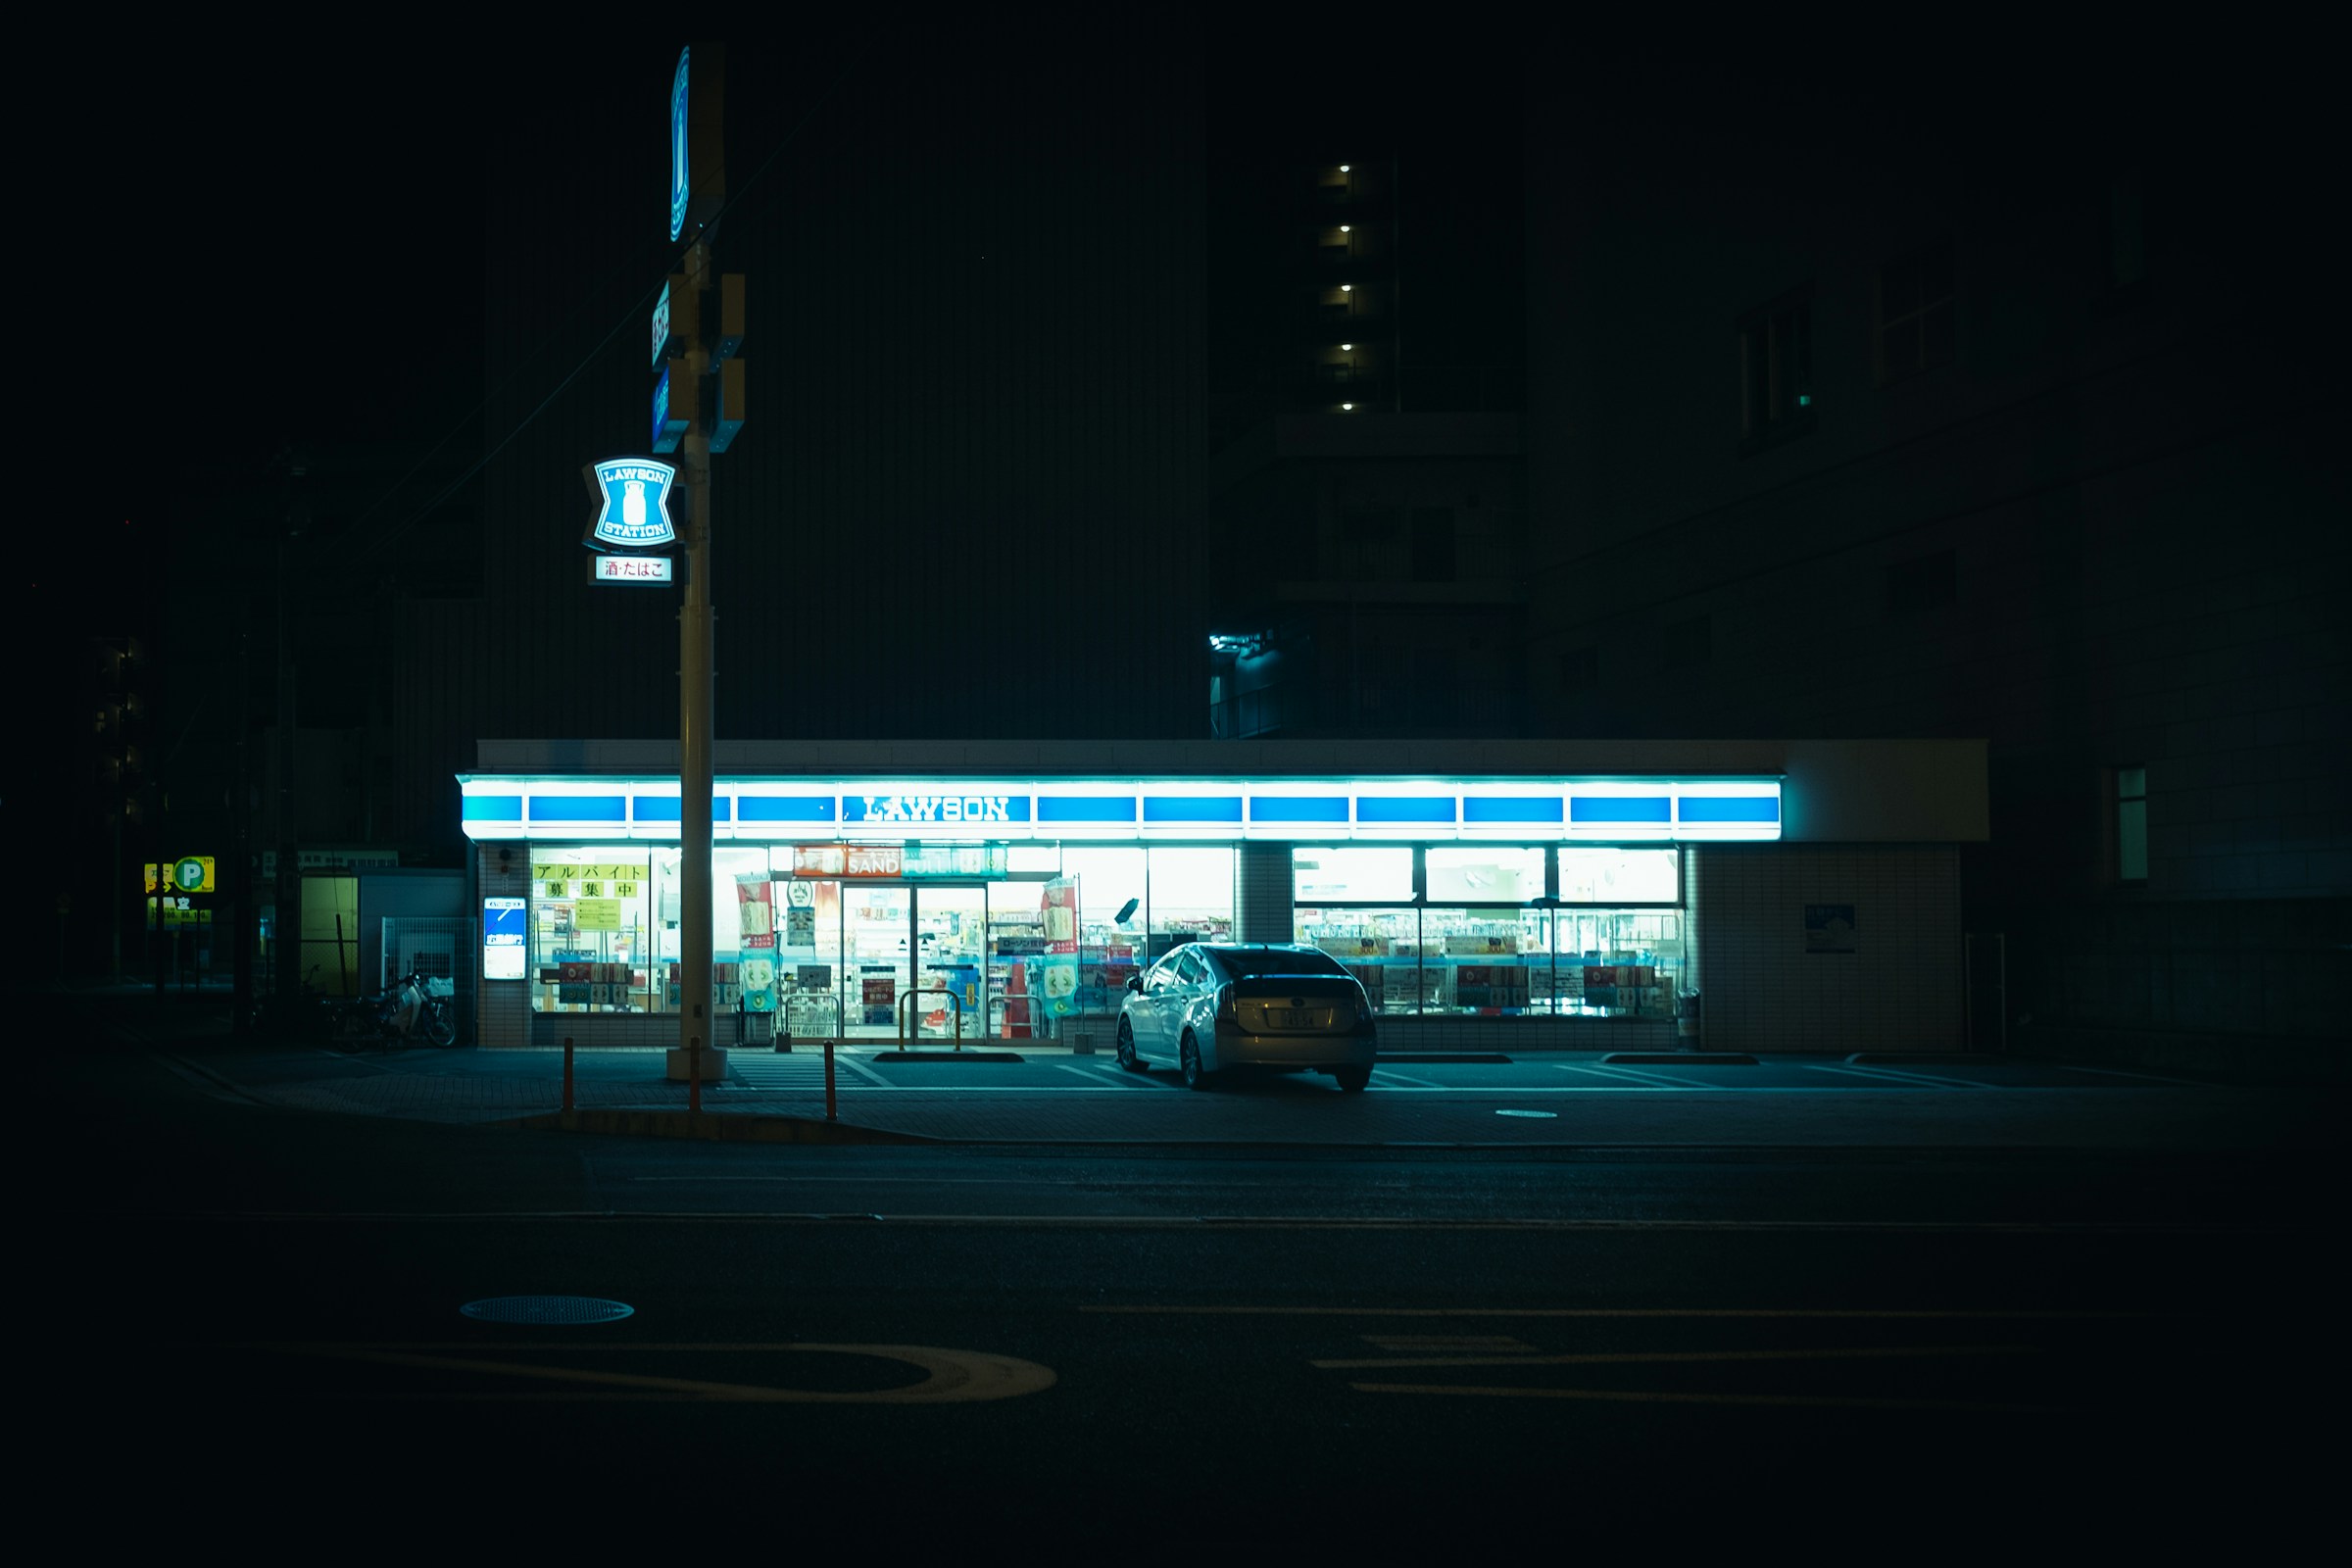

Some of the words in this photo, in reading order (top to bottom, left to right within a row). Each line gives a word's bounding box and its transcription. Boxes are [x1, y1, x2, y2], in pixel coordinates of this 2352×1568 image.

[604, 467, 665, 484] LAWSON
[604, 522, 664, 538] STATION
[863, 797, 1009, 821] LAWSON
[538, 866, 640, 880] アルバイト
[849, 858, 900, 874] SAND
[184, 864, 201, 886] P
[549, 883, 631, 897] 募集中
